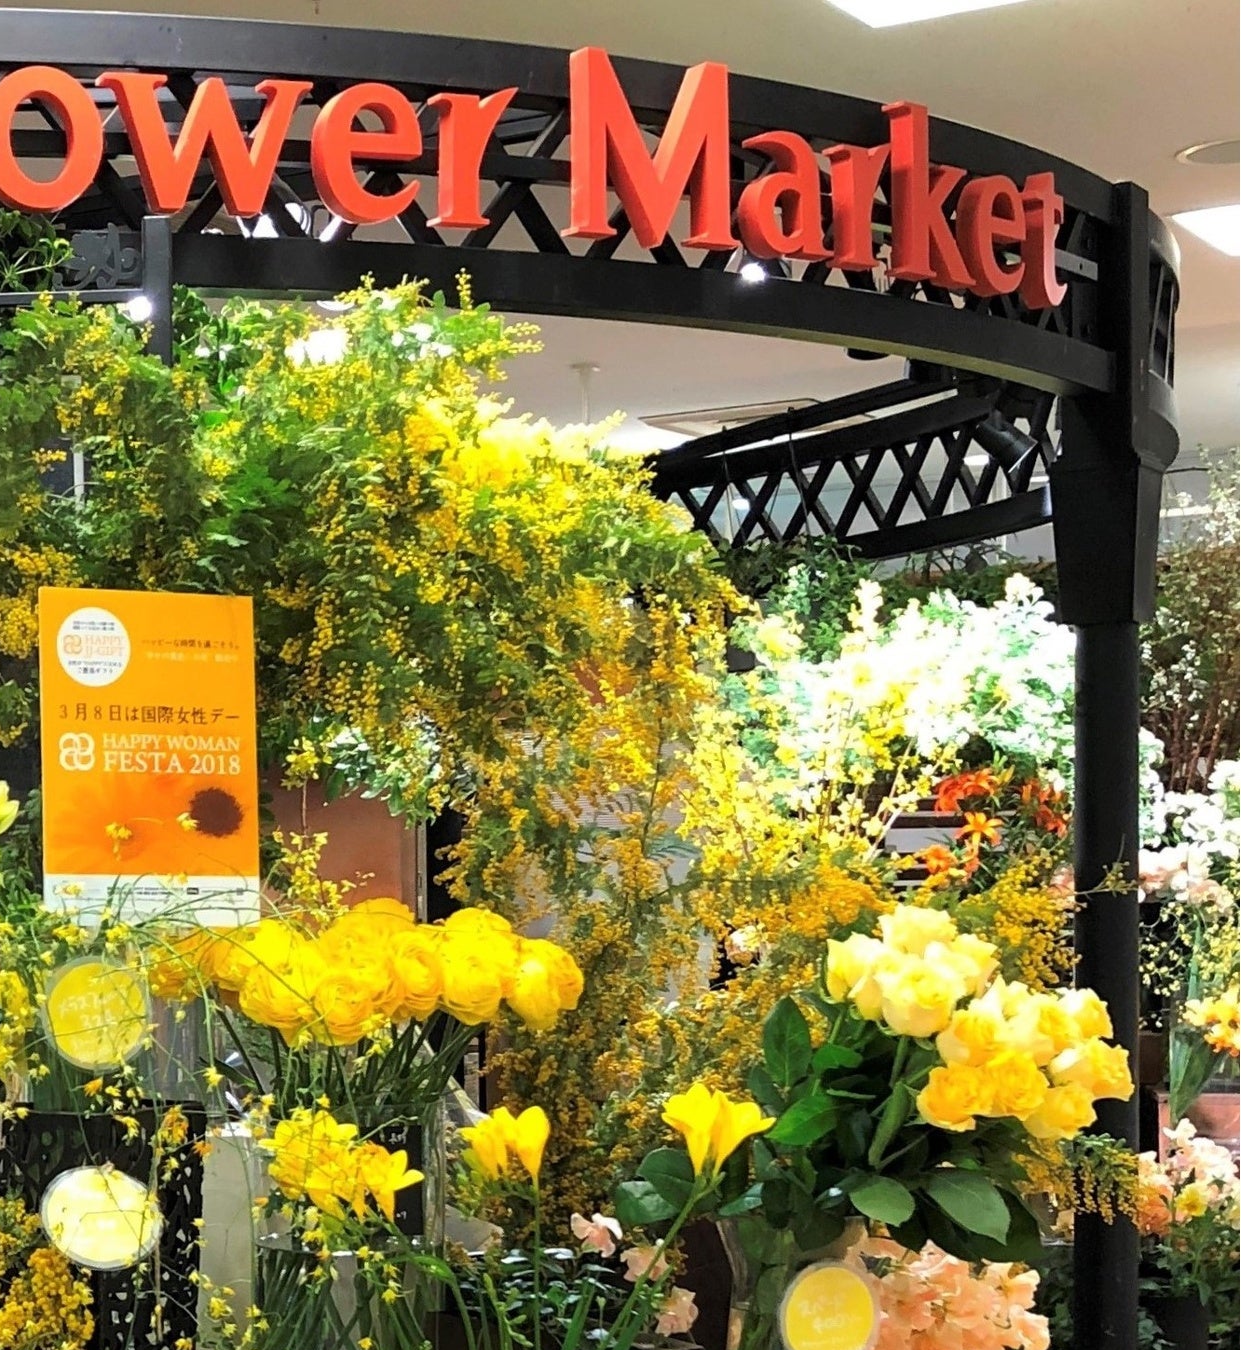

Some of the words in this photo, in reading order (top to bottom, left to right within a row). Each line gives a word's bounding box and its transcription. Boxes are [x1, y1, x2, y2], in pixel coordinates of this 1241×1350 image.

[561, 46, 1069, 310] Market
[103, 733, 161, 750] HAPPY
[166, 735, 241, 753] WOMAN
[103, 751, 184, 774] FESTA
[189, 754, 241, 776] 2018
